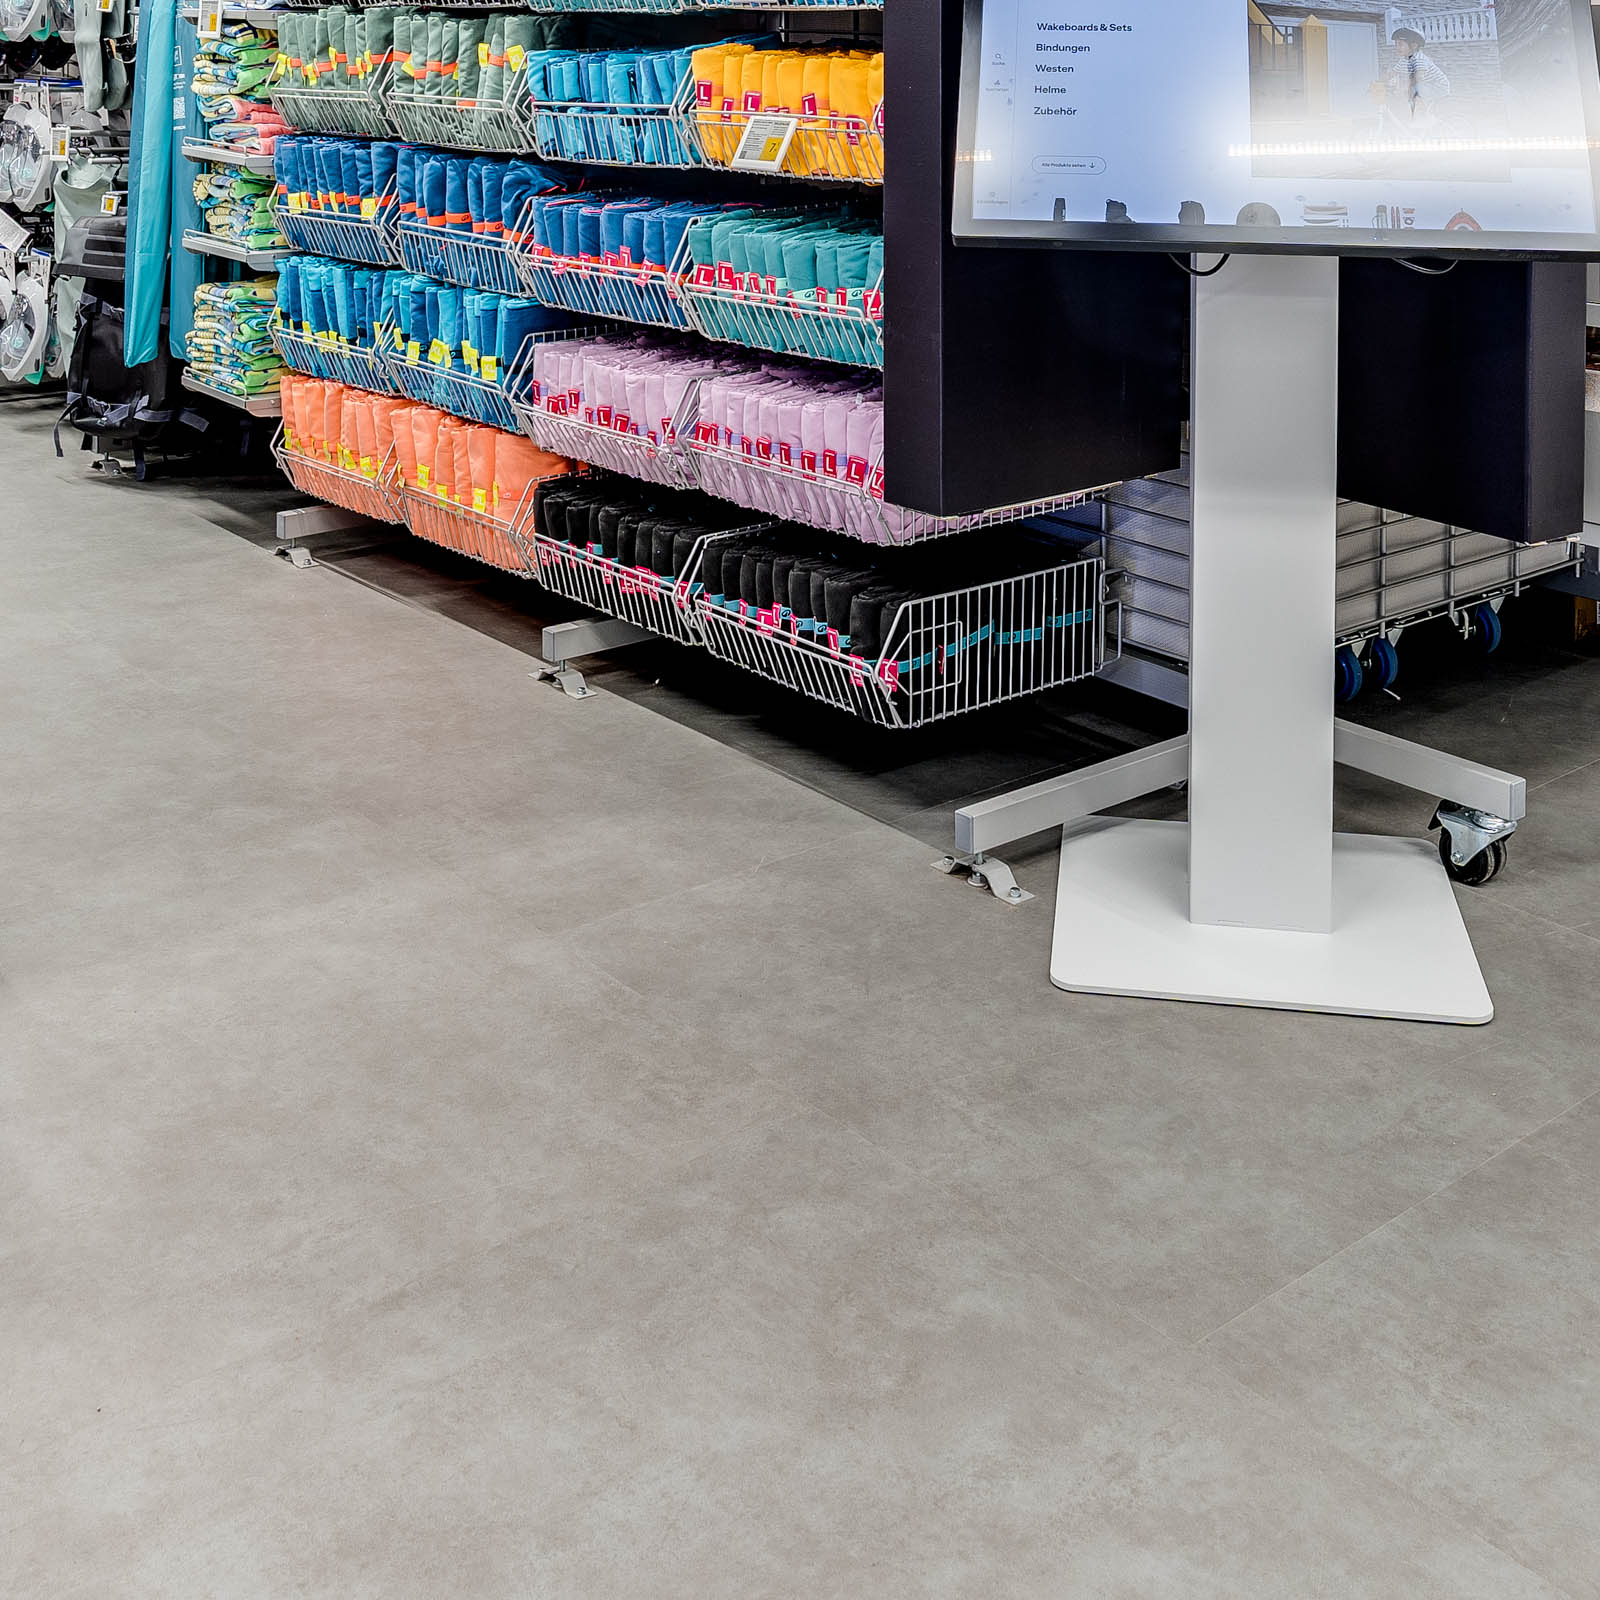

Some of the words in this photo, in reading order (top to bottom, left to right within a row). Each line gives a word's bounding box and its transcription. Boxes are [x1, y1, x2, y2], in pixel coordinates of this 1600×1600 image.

[1036, 22, 1099, 32] Wakeboards
[1099, 23, 1108, 32] &
[1109, 22, 1133, 33] Sets
[1035, 43, 1091, 53] Bindungen
[1035, 64, 1074, 73] Westen
[1034, 85, 1067, 94] Helme
[1033, 106, 1077, 116] Zubehör
